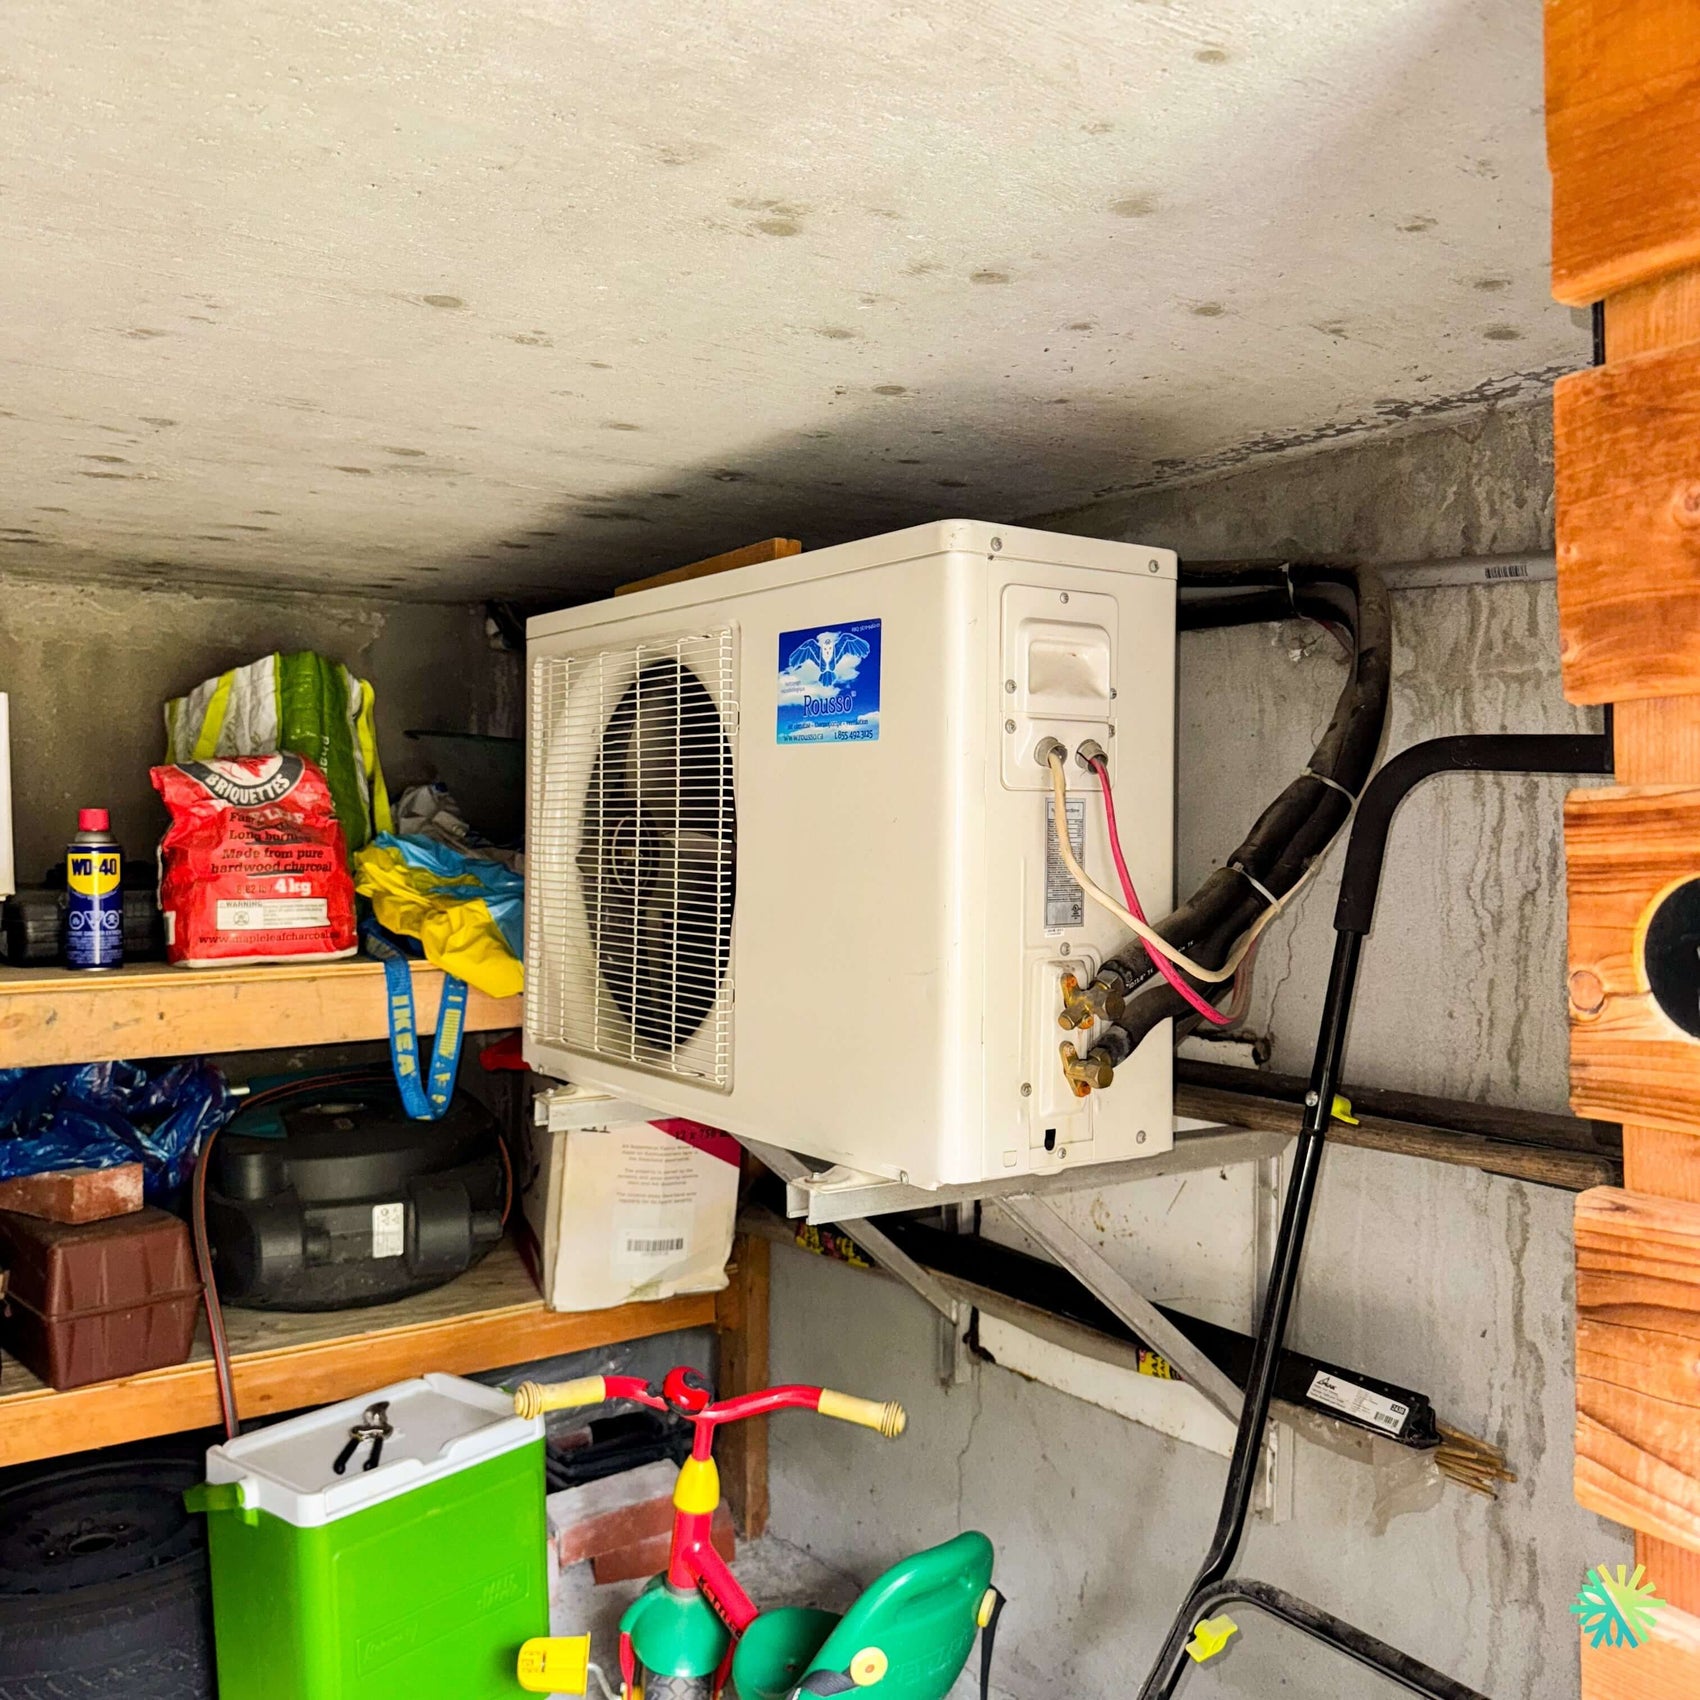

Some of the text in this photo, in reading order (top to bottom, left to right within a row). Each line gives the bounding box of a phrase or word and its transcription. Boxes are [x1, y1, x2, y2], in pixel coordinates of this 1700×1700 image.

[803, 694, 853, 718] Rousso
[204, 772, 291, 806] BRIQUETTES
[222, 848, 324, 861] Made from pure
[71, 858, 118, 876] WD-40
[211, 861, 332, 874] hardwood charcoal
[226, 901, 263, 909] WARNING
[391, 994, 416, 1077] IKEA
